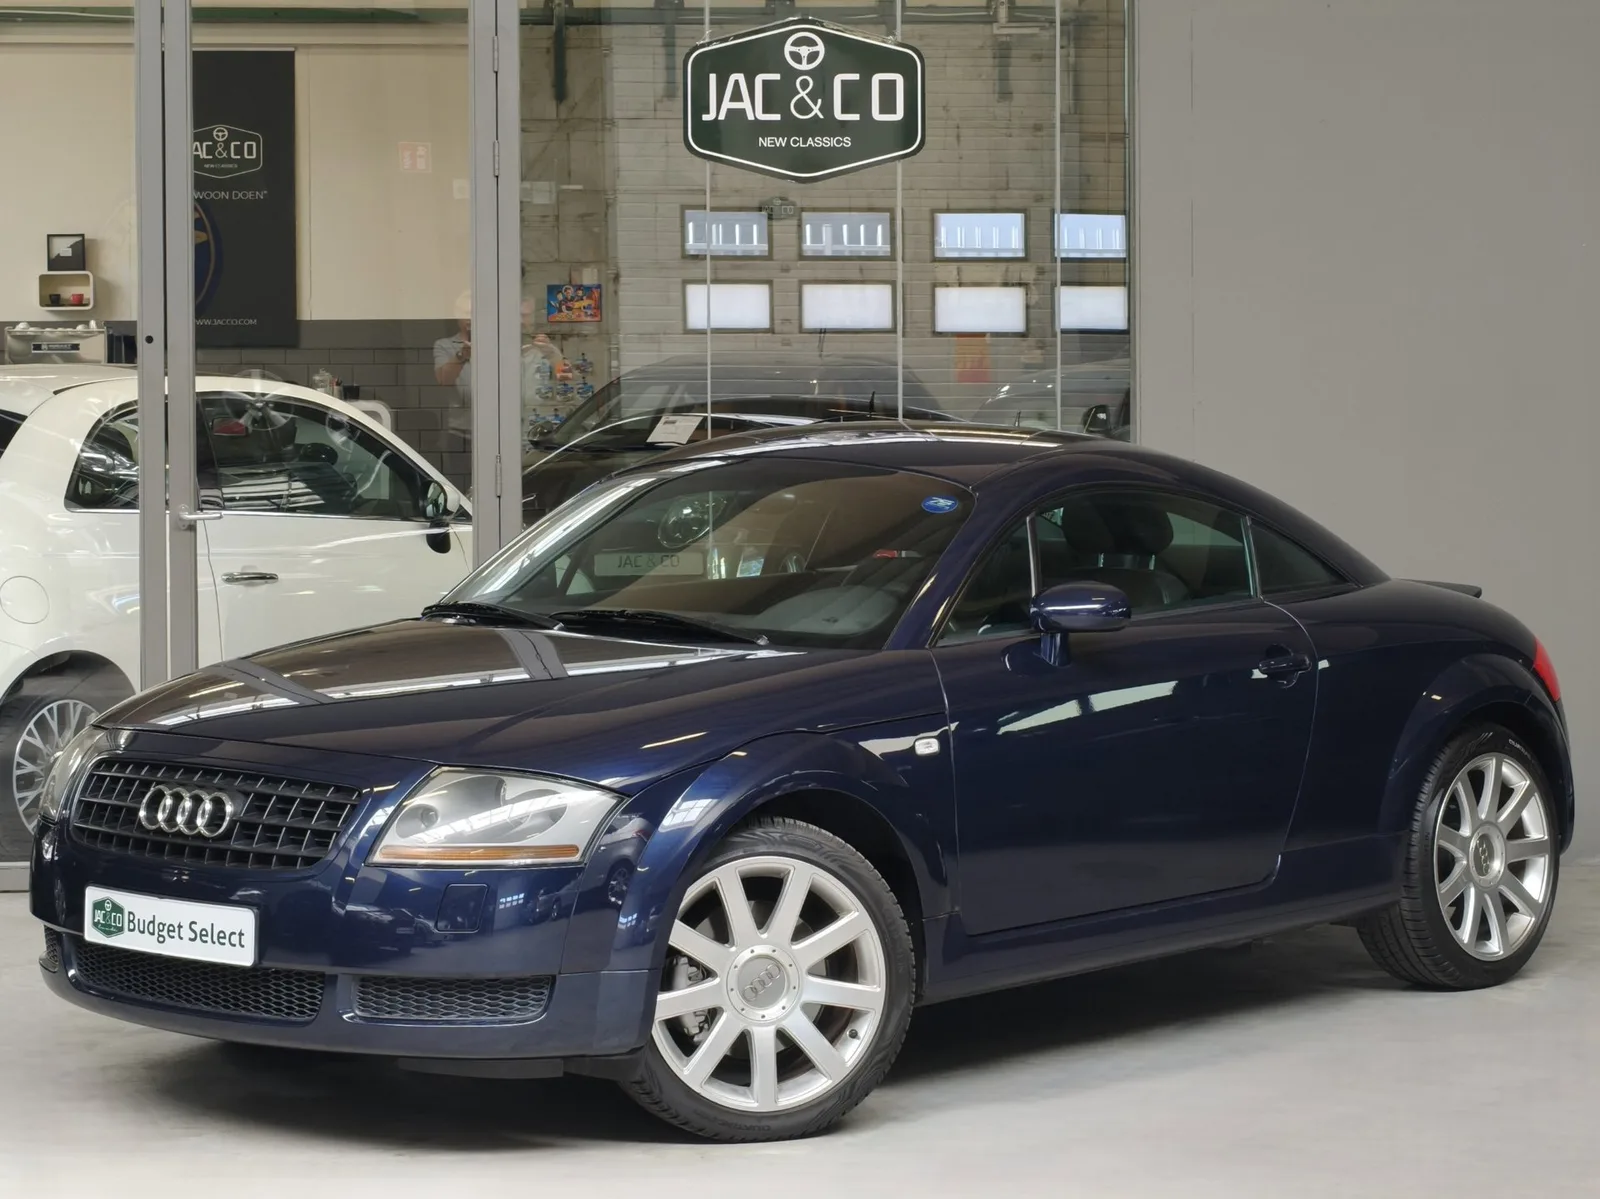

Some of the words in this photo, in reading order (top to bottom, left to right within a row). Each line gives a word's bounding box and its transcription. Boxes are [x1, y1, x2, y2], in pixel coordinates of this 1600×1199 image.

[758, 137, 787, 147] NEW
[790, 136, 851, 148] CLASSICS
[127, 911, 184, 944] Budget
[188, 921, 245, 948] Select
